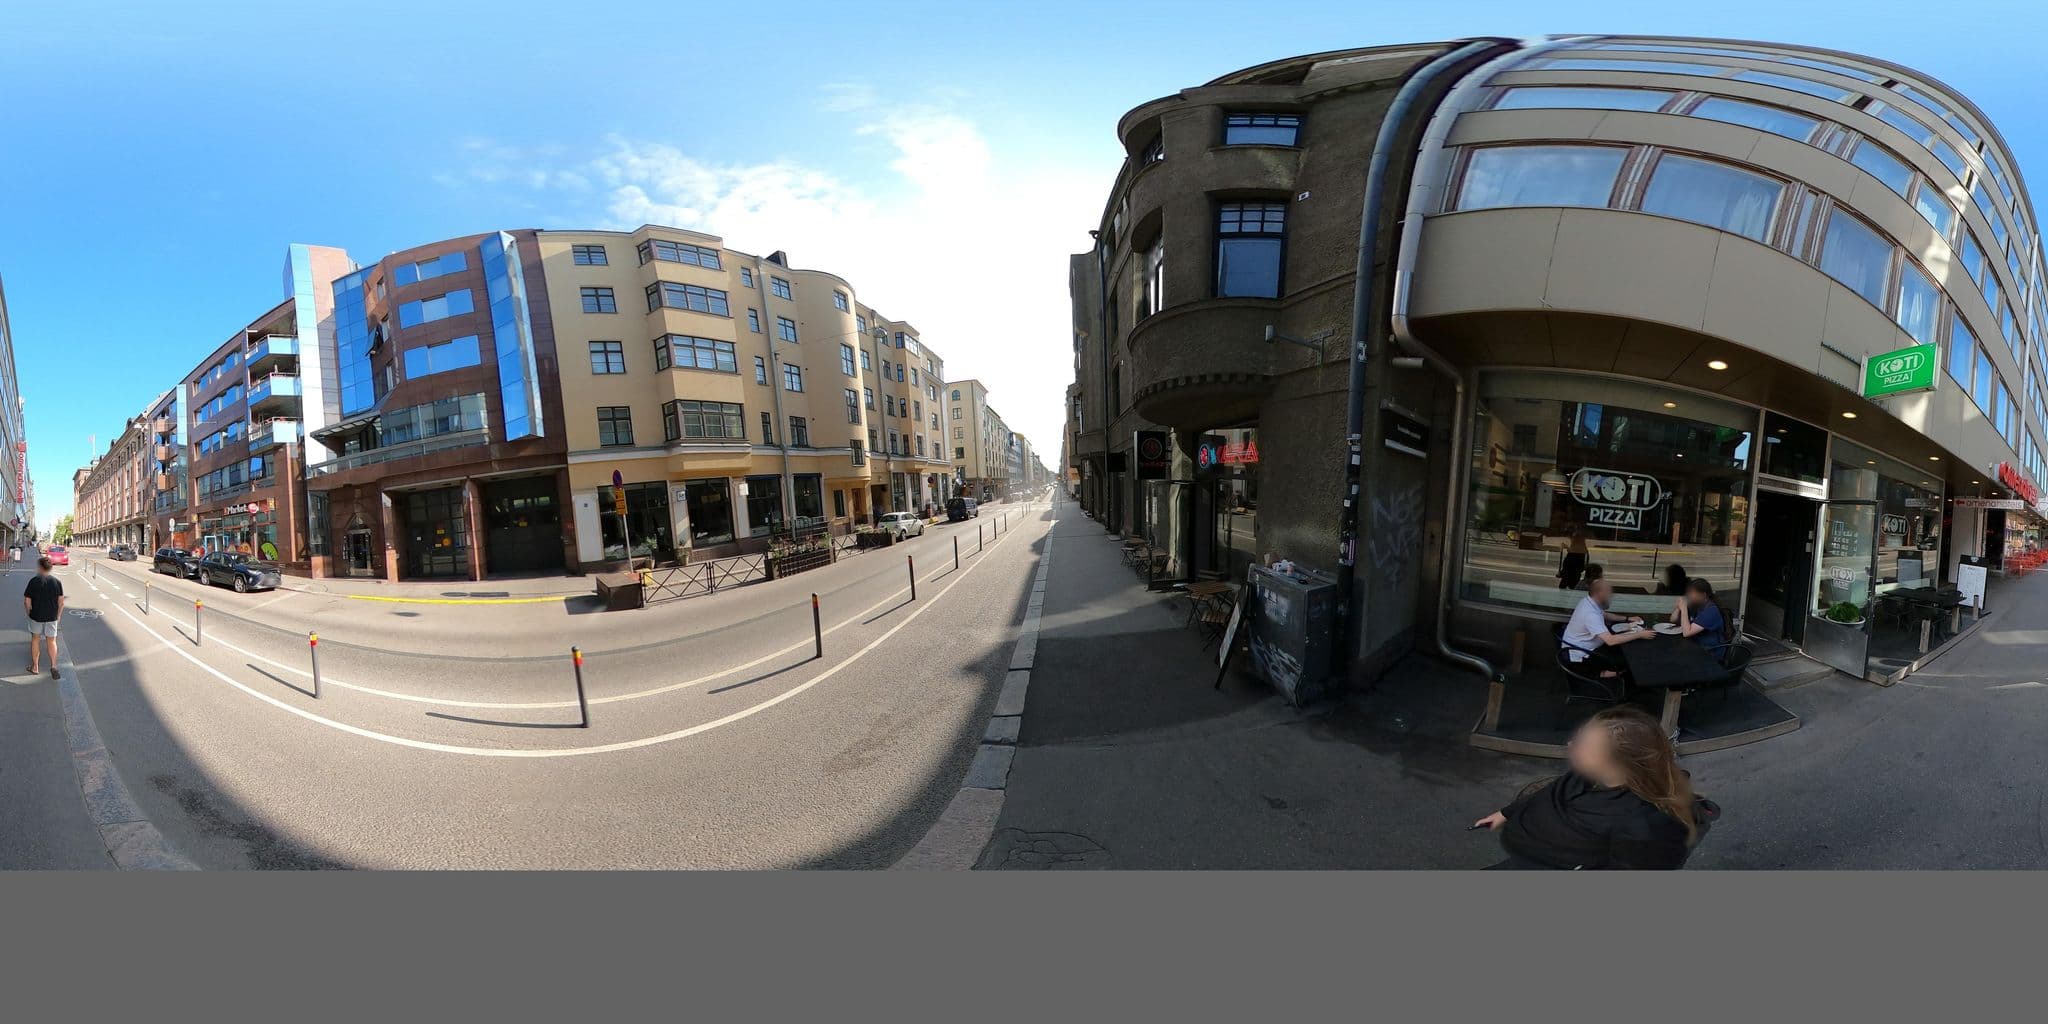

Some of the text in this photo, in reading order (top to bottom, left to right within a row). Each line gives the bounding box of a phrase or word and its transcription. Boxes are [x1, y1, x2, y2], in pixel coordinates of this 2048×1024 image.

[1880, 355, 1918, 375] KOTI
[1884, 373, 1909, 385] PIZZA
[1581, 472, 1651, 505] KOTI
[1590, 508, 1635, 525] PIZZA
[1883, 515, 1906, 533] KOTI
